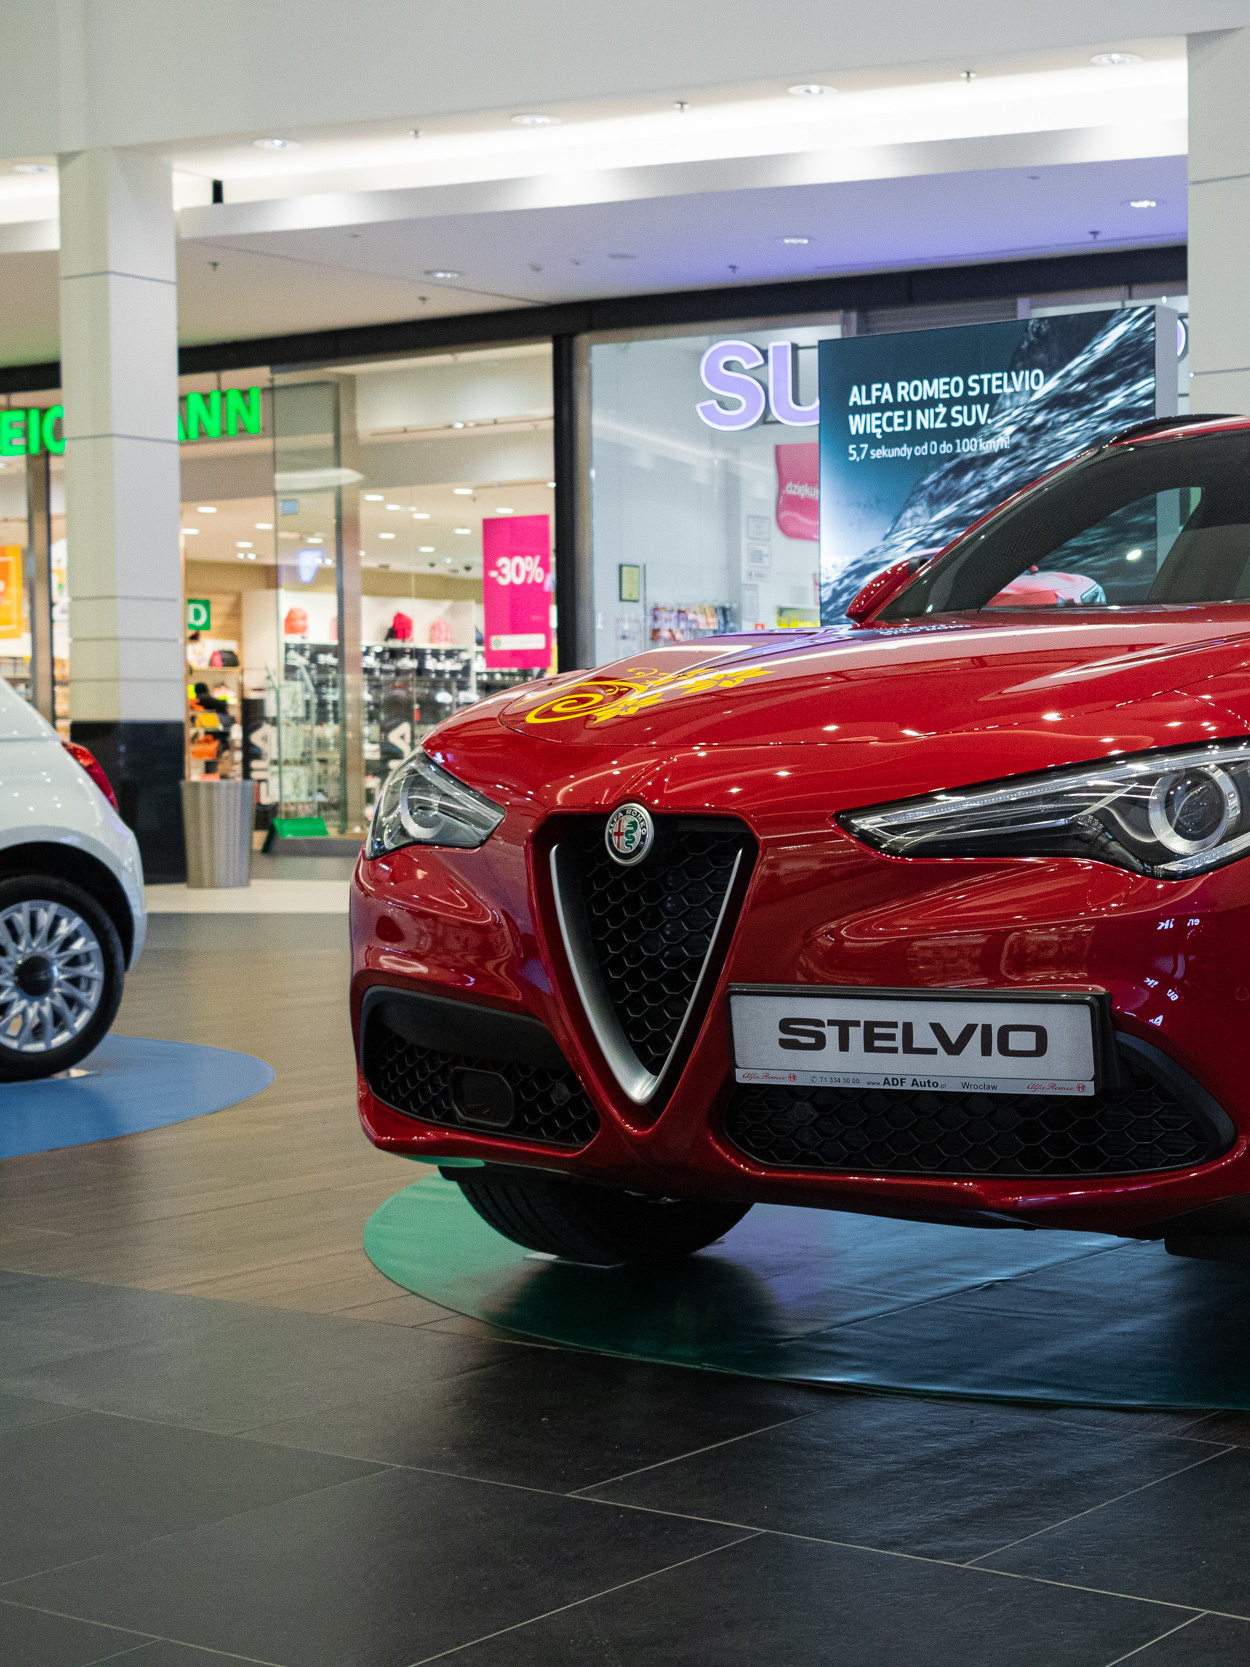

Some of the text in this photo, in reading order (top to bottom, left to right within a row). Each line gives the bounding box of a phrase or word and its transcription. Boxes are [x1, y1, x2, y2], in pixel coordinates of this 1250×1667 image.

[848, 369, 1044, 406] ALFA ROMEO STELVIO
[848, 403, 992, 439] WIĘCEJ NIŻ SUV.
[848, 444, 868, 462] 5,7
[870, 444, 912, 460] sekundy
[914, 442, 928, 456] od
[929, 441, 937, 455] 0
[939, 440, 953, 454] do
[955, 438, 977, 453] 100
[488, 555, 545, 585] -30%
[778, 1017, 1048, 1058] STELVIO
